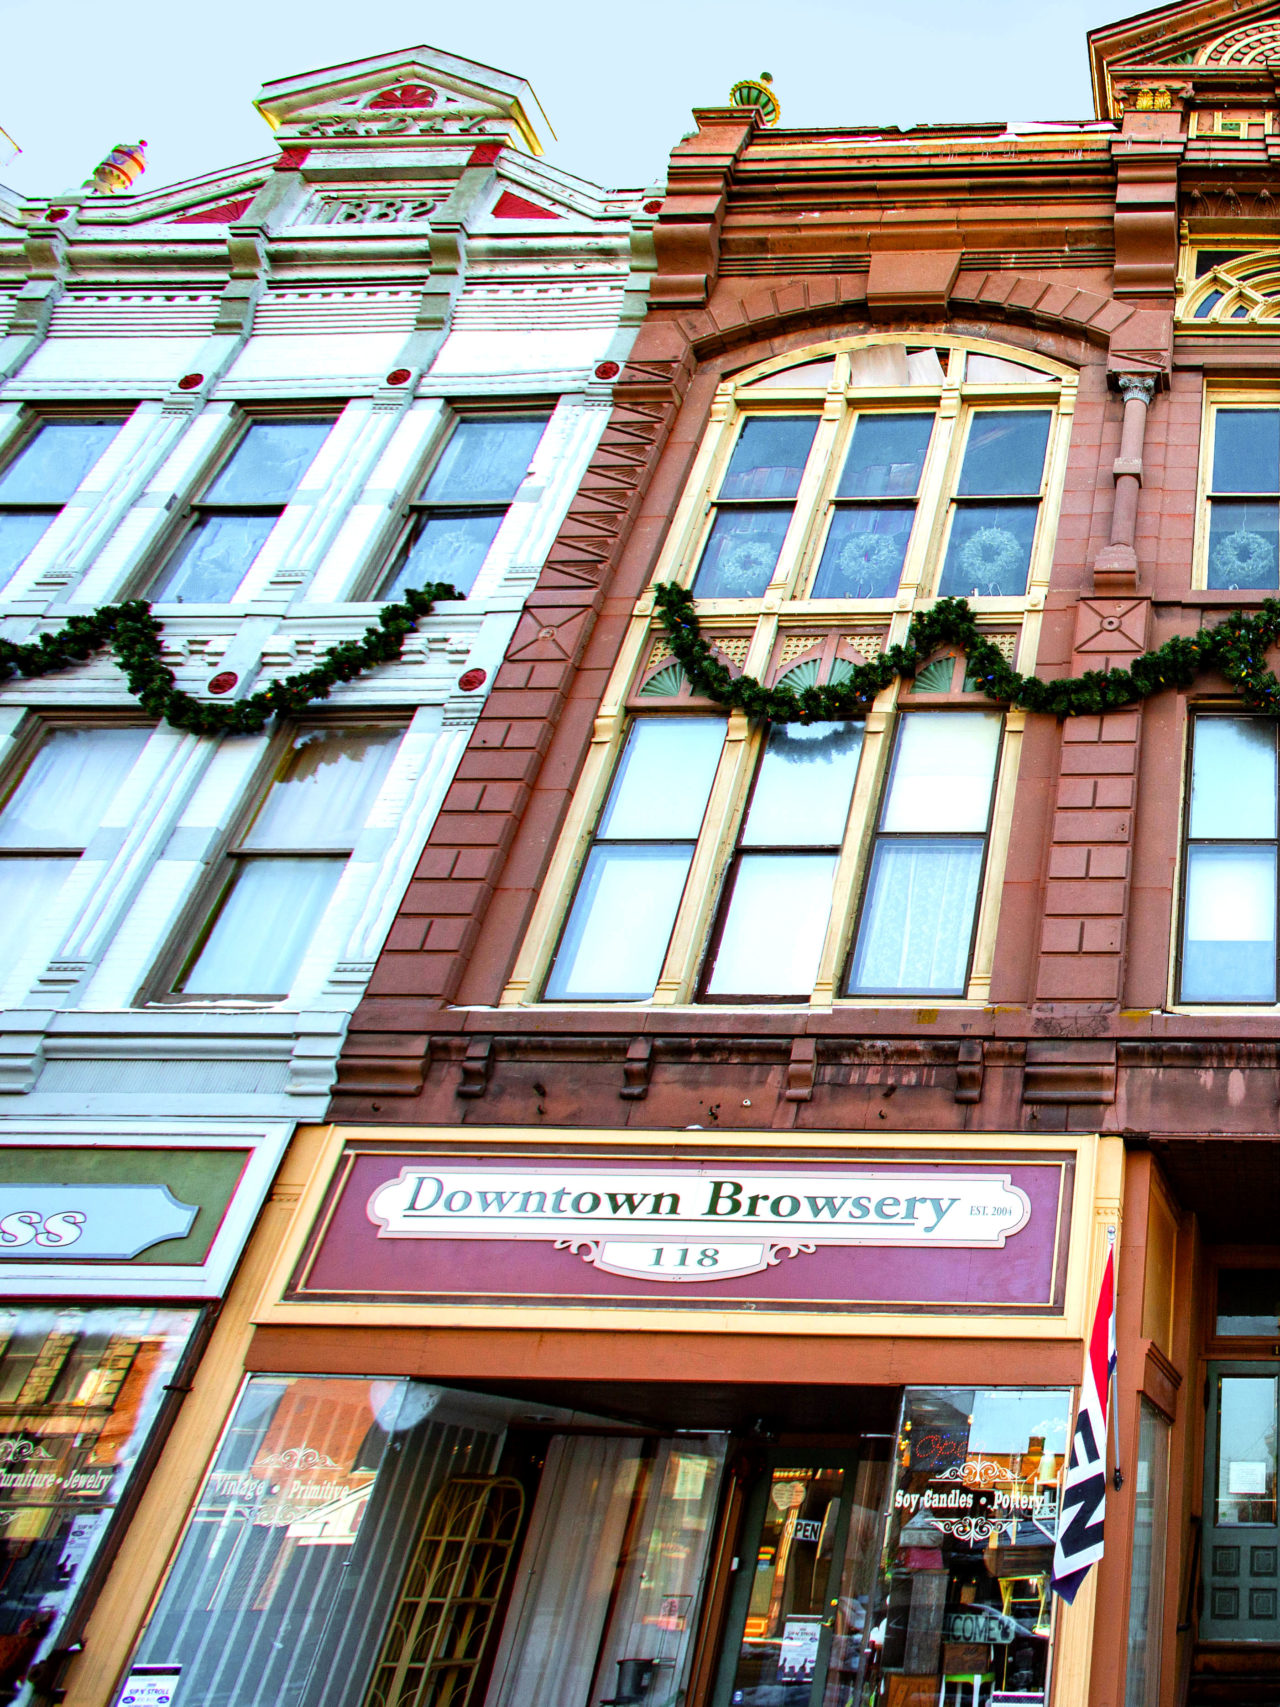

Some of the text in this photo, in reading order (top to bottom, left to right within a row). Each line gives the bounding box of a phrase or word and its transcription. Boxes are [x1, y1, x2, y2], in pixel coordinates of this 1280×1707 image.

[403, 1176, 961, 1233] Downtown Browsery
[969, 1205, 989, 1216] EST.
[648, 1248, 720, 1268] 118
[62, 1469, 113, 1491] Jewelry
[215, 1476, 350, 1501] Vintage Primitive
[895, 1489, 1045, 1515] Soy Candles Pottery
[950, 1615, 998, 1642] COME
